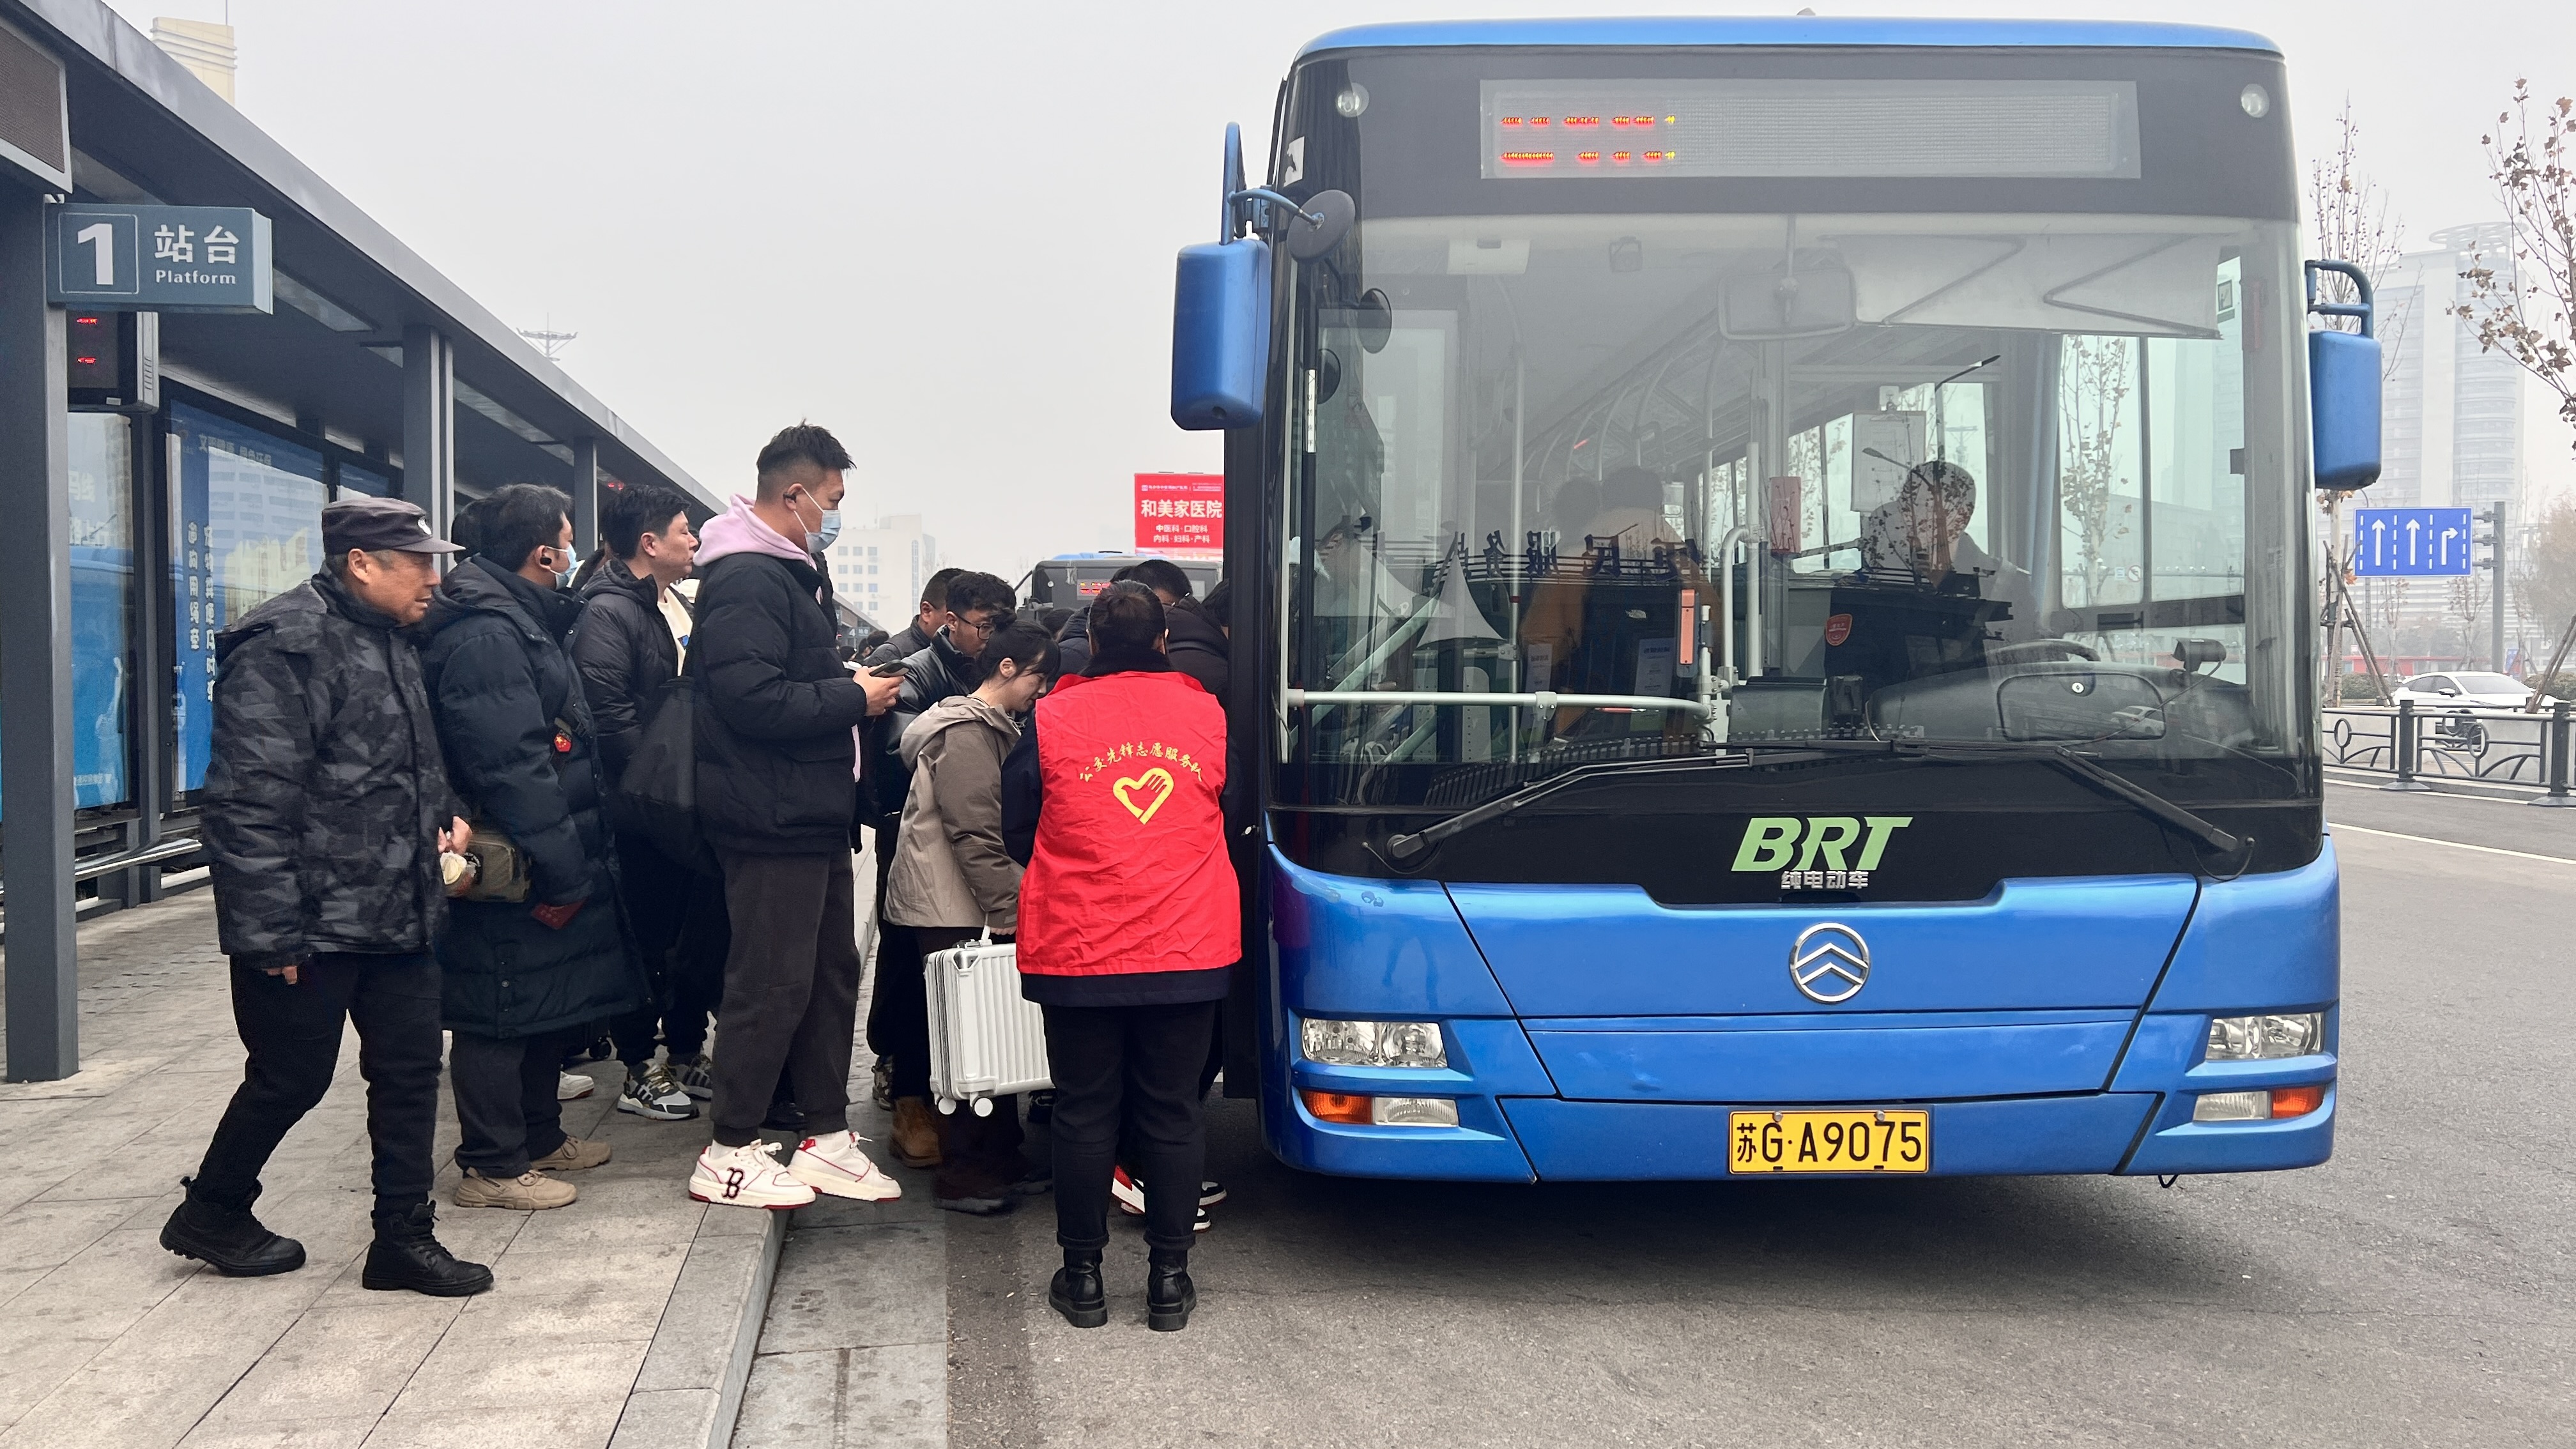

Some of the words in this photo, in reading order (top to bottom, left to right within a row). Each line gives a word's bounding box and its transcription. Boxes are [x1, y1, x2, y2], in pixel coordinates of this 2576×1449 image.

[77, 223, 114, 285] 1
[154, 224, 240, 264] 站台
[155, 269, 236, 285] Platform
[1141, 499, 1222, 518] 和美家医院
[848, 628, 856, 637] 4
[1079, 741, 1202, 782] 公交先锋志愿服务队
[1731, 816, 1914, 871] BRT
[1781, 870, 1869, 889] 纯电动车
[1736, 1121, 1922, 1163] 苏G·A9075
[721, 1167, 746, 1200] B
